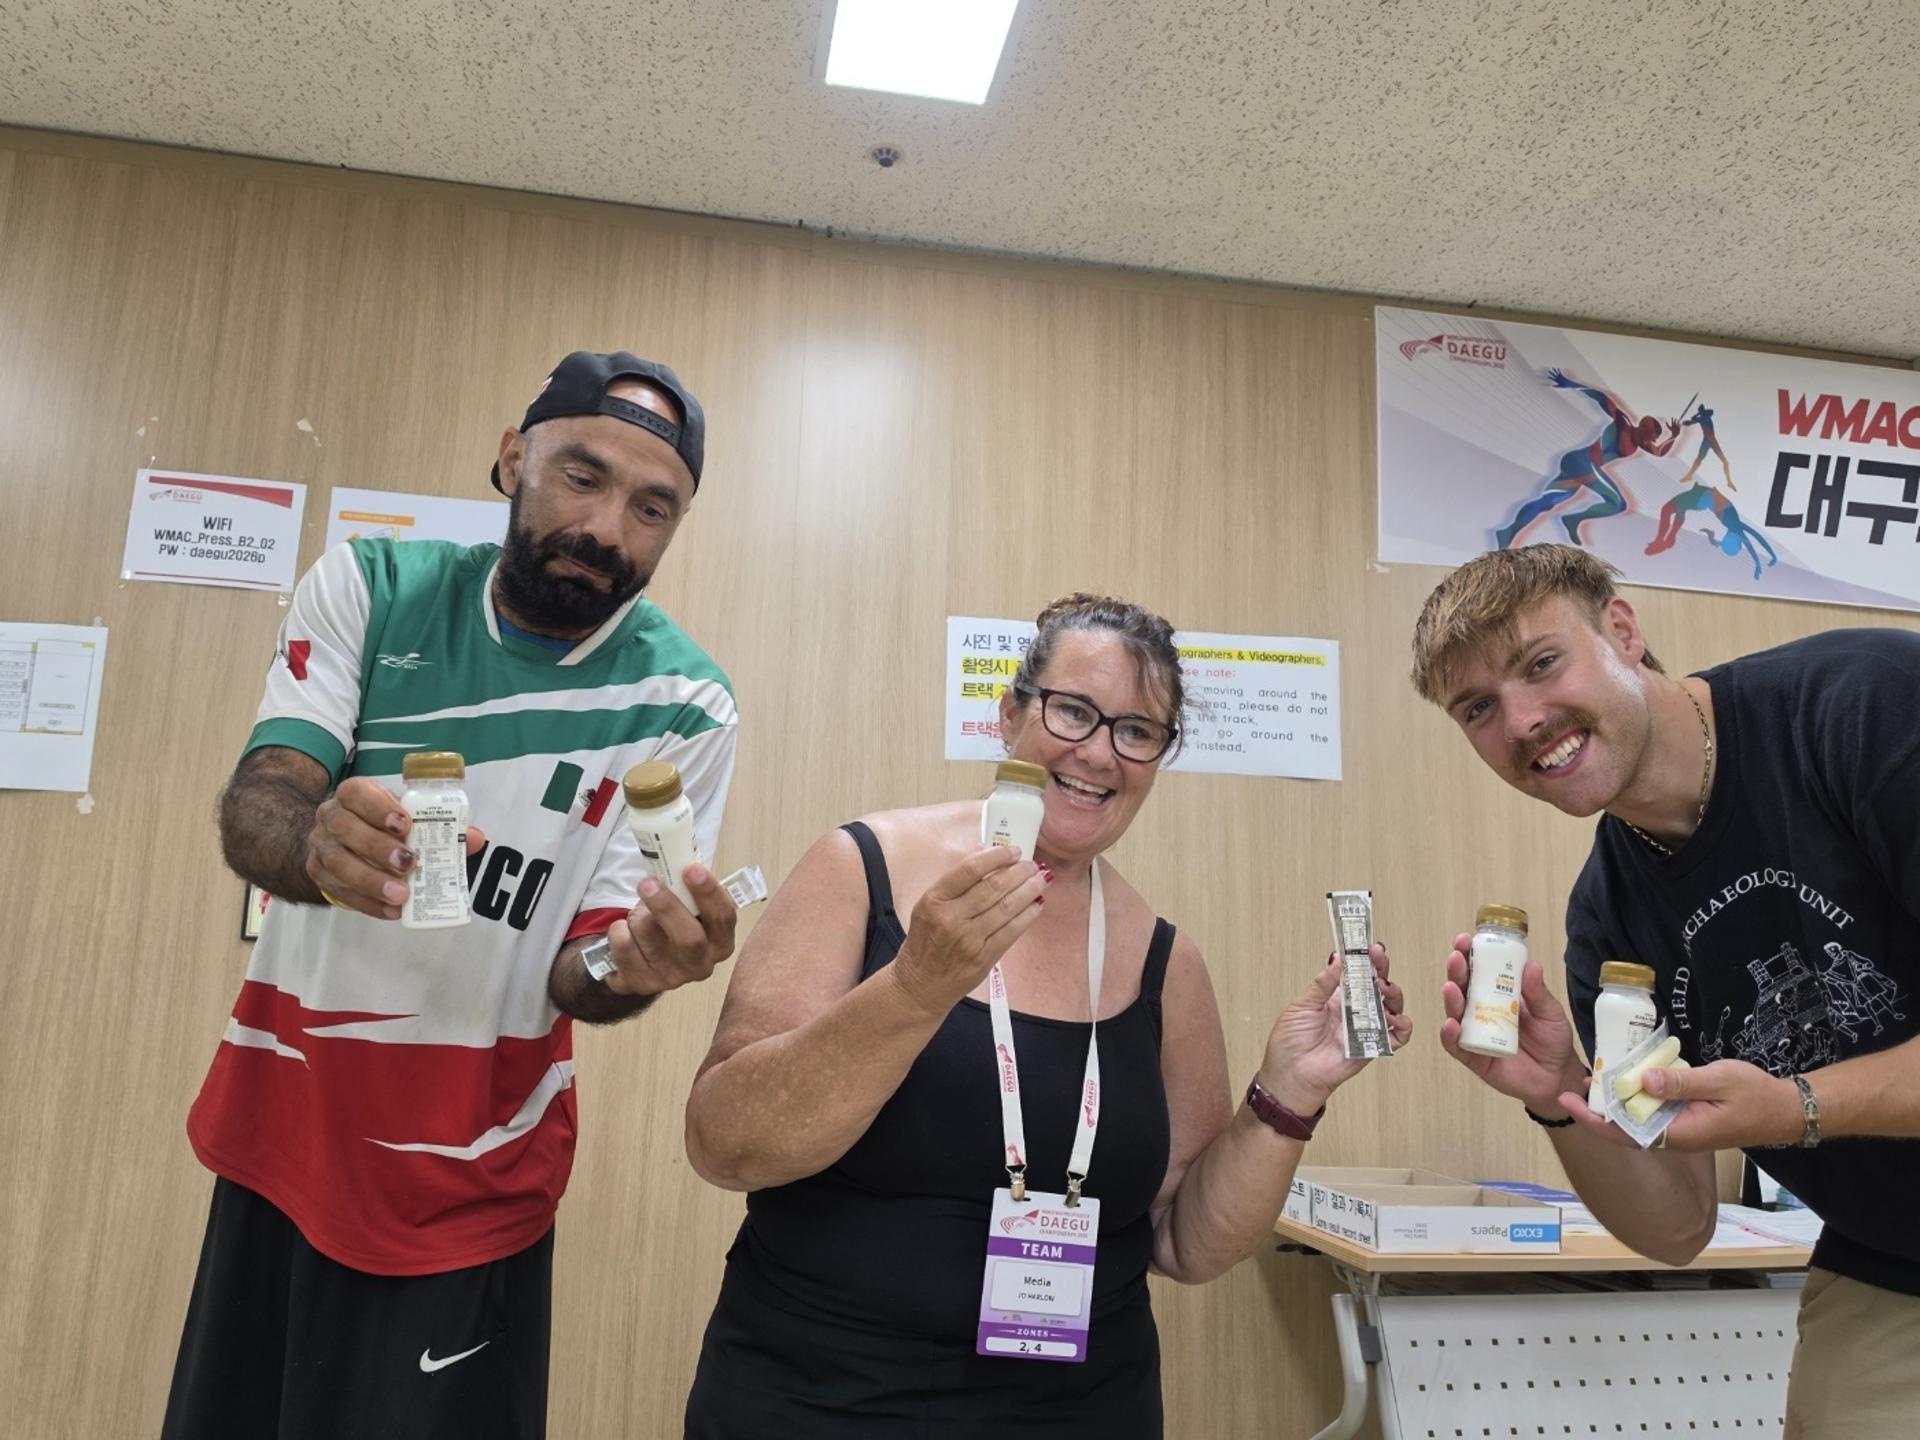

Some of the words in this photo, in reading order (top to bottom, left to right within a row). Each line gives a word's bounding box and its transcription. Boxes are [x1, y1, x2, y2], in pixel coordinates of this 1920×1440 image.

[1447, 342, 1506, 360] DAEGU
[154, 528, 276, 550] WMAC_Press_B2_02
[158, 543, 179, 556] PW
[190, 546, 266, 563] daegu2026p
[962, 633, 991, 650] 사진
[998, 635, 1012, 651] 및
[1017, 636, 1031, 653] 영
[1237, 650, 1245, 660] &
[962, 657, 1009, 675] 촬영시
[961, 682, 994, 699] 트랙
[1203, 686, 1244, 698] moving
[1258, 688, 1297, 699] around
[1311, 691, 1328, 701] the
[1239, 701, 1279, 712] please
[1287, 704, 1302, 713] do
[1310, 705, 1328, 715] not
[1198, 713, 1217, 722] the
[1217, 729, 1233, 739] go
[1251, 730, 1293, 741] around
[1310, 733, 1329, 743] the
[1671, 966, 1692, 1030] FIELD
[1799, 883, 1855, 929] UNIT
[1040, 1215, 1090, 1232] DAEGU
[1471, 1224, 1508, 1237] Papers
[1513, 1228, 1544, 1238] EXXO
[1021, 1242, 1063, 1259] TEAM
[1024, 1276, 1052, 1287] Media
[1016, 1328, 1049, 1337] ZONES
[1019, 1341, 1030, 1353] 2,
[1034, 1343, 1042, 1353] 4
